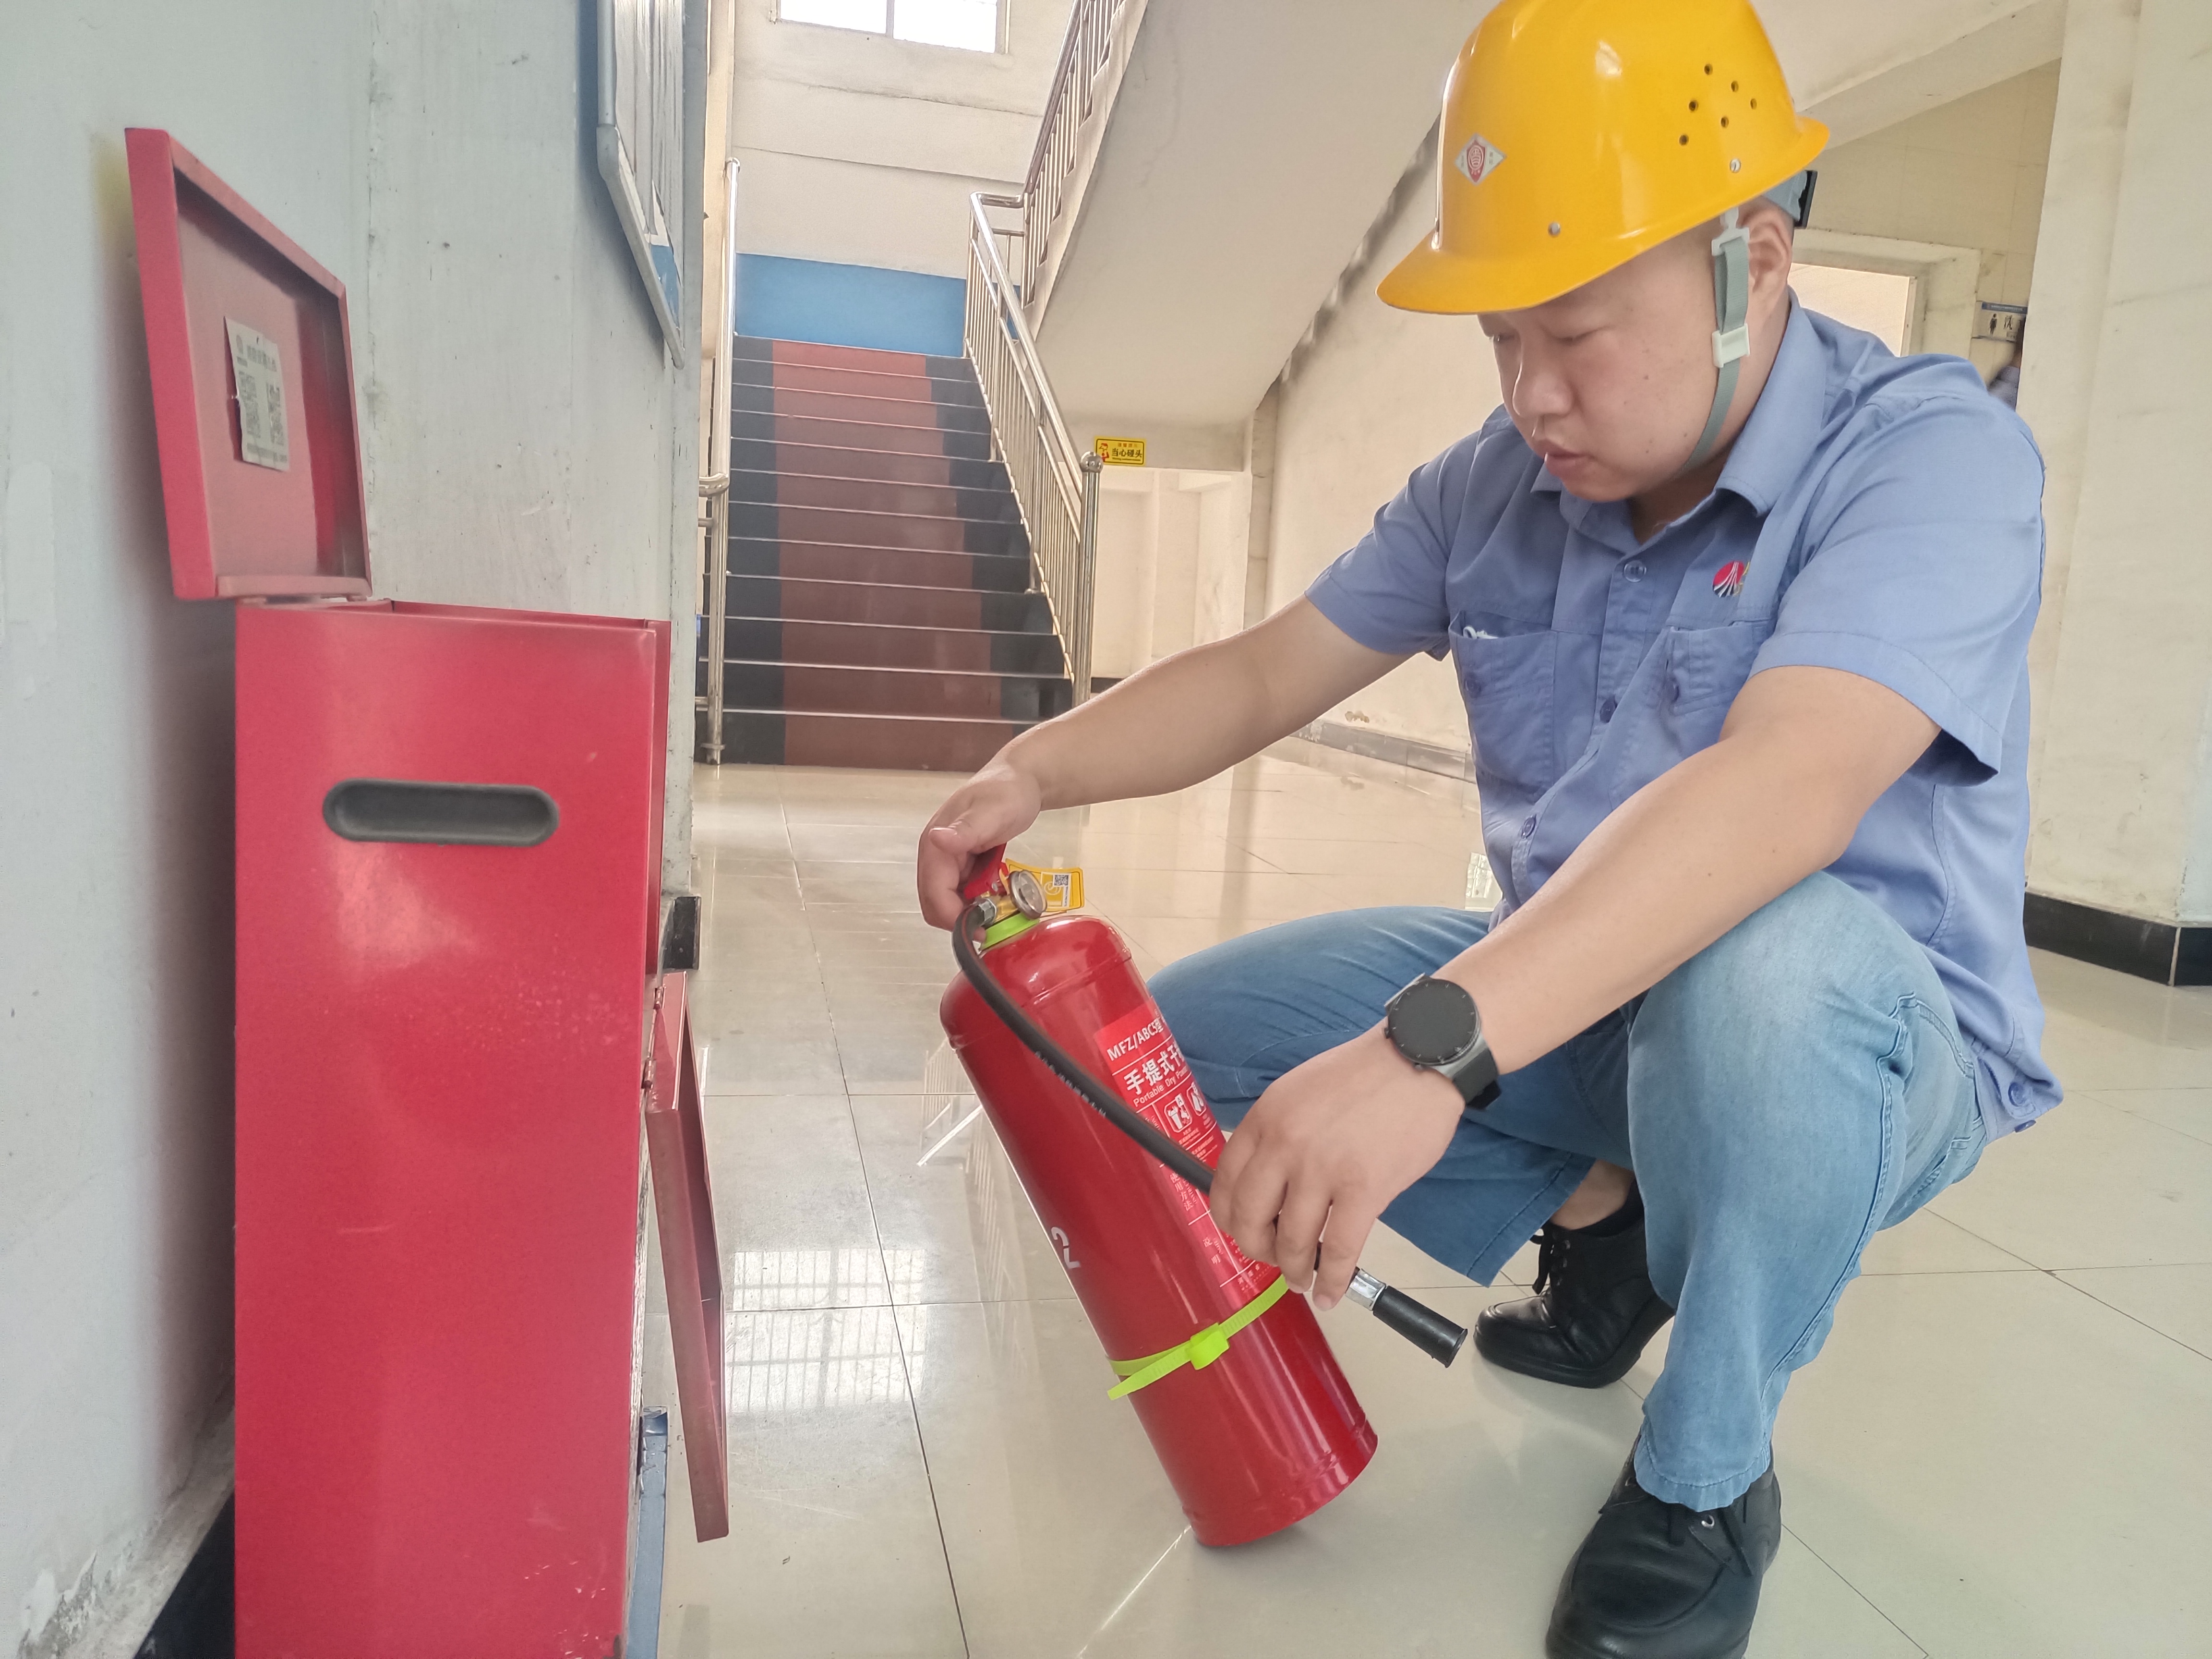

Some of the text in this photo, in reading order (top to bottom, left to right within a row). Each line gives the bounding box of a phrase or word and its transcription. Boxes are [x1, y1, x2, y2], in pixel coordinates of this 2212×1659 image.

[1112, 448, 1142, 457] 当心碰头
[1133, 1084, 1165, 1107] Portable
[1165, 1076, 1176, 1087] Dry
[1051, 1227, 1081, 1269] 2
